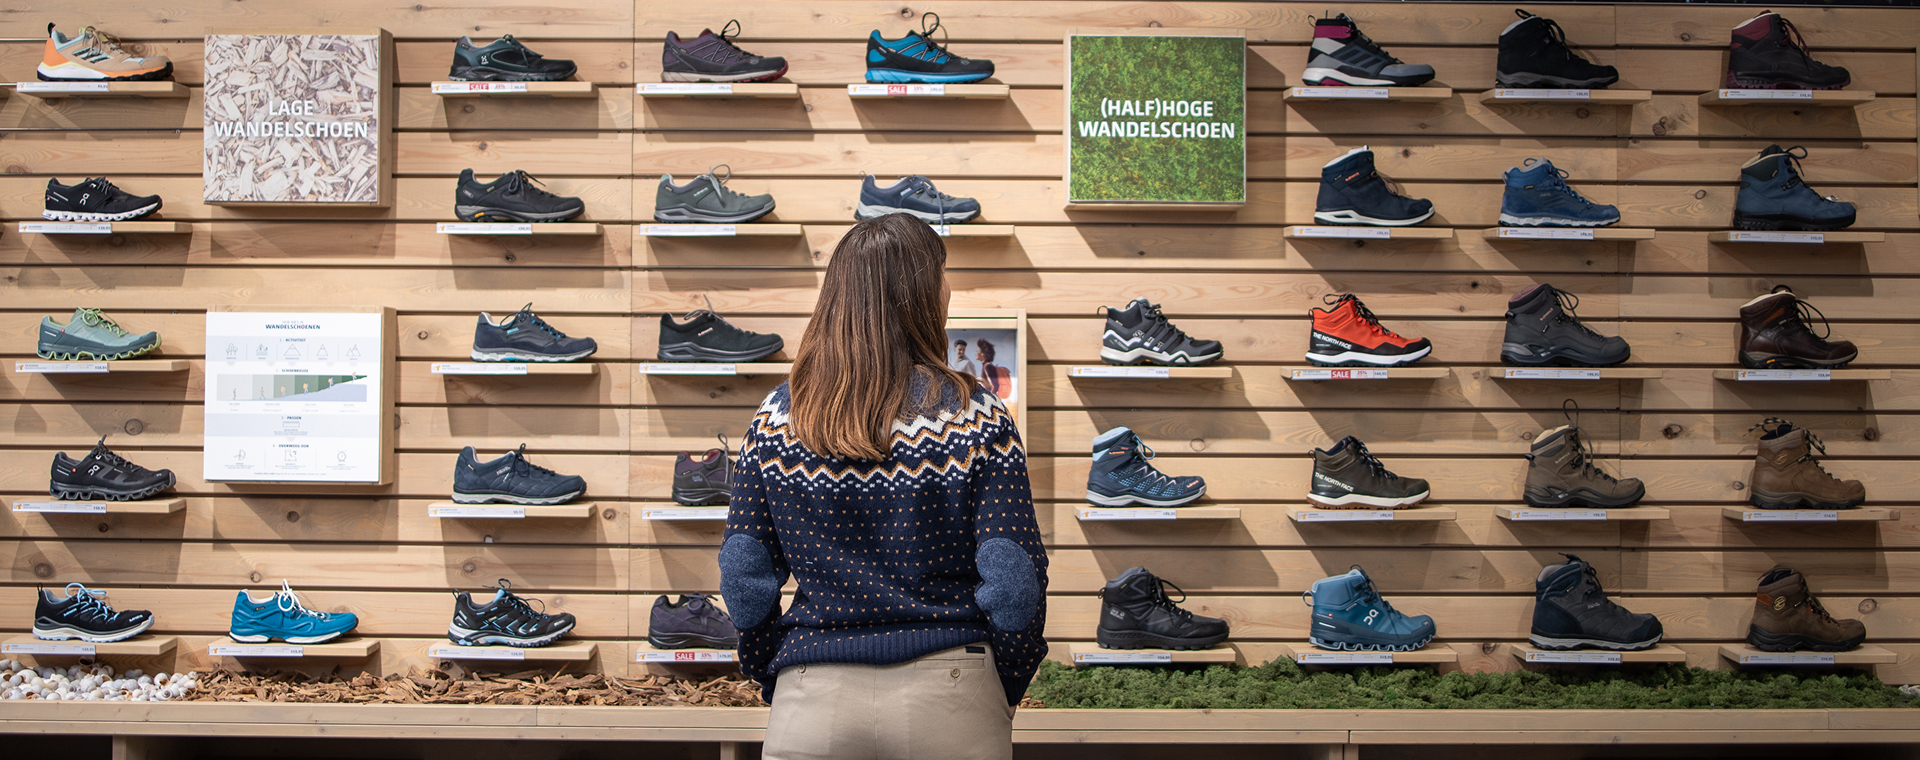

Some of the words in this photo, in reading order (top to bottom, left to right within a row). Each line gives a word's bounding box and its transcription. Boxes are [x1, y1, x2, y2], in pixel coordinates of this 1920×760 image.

[269, 100, 314, 116] LAGE
[1101, 97, 1214, 119] (HALF)HOGE
[214, 121, 368, 138] WANDELSCHOEN
[1078, 121, 1235, 138] WANDELSCHOEN
[1313, 331, 1322, 340] THE
[1322, 335, 1339, 345] NORTH
[1338, 340, 1352, 350] FACE
[1332, 370, 1349, 378] SALE
[1315, 471, 1324, 480] THE
[1324, 475, 1341, 486] NORTH
[1341, 482, 1354, 493] FACE
